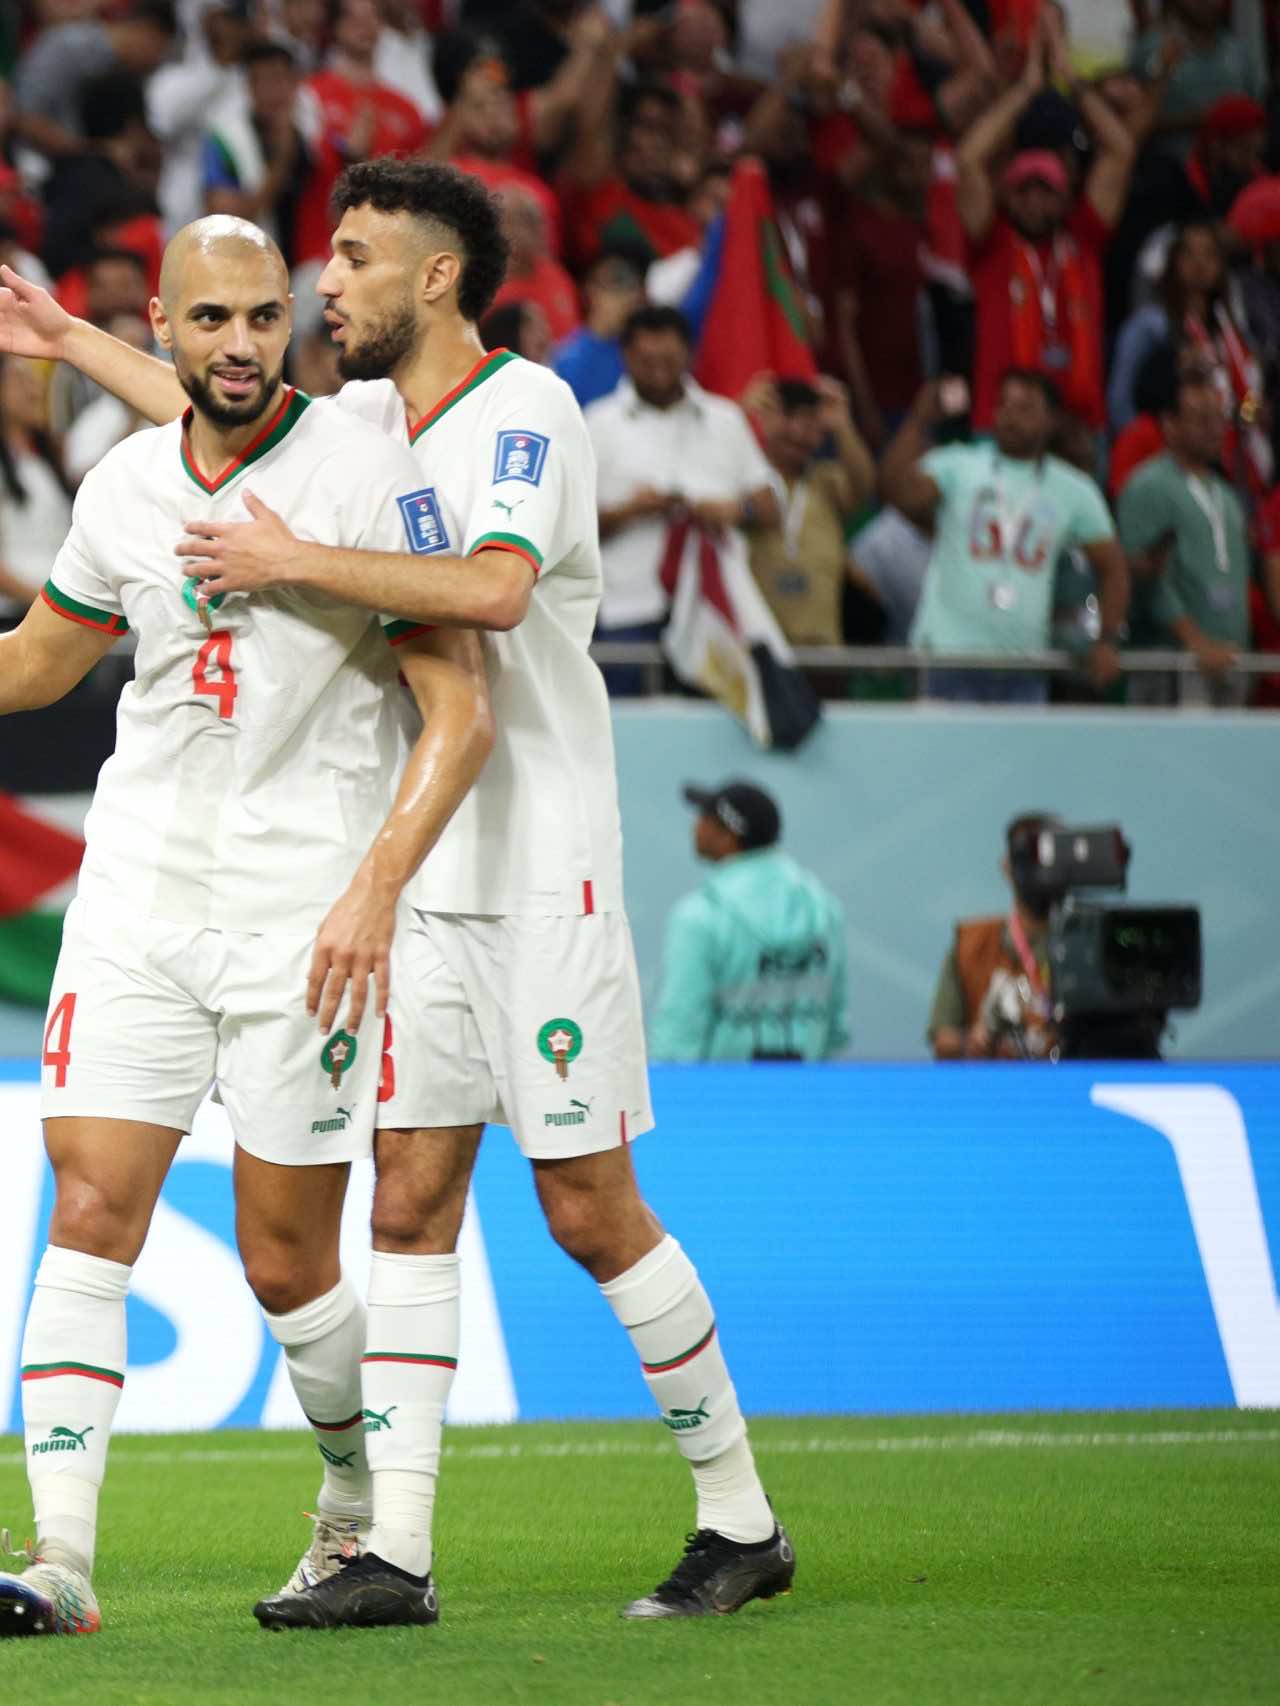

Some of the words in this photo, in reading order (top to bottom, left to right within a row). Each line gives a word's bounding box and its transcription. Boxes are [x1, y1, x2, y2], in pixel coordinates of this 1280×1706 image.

[192, 630, 238, 718] 4
[43, 992, 77, 1088] 4
[311, 1117, 346, 1134] PUMA
[544, 1110, 585, 1127] PUMA
[32, 1439, 77, 1456] PUMA
